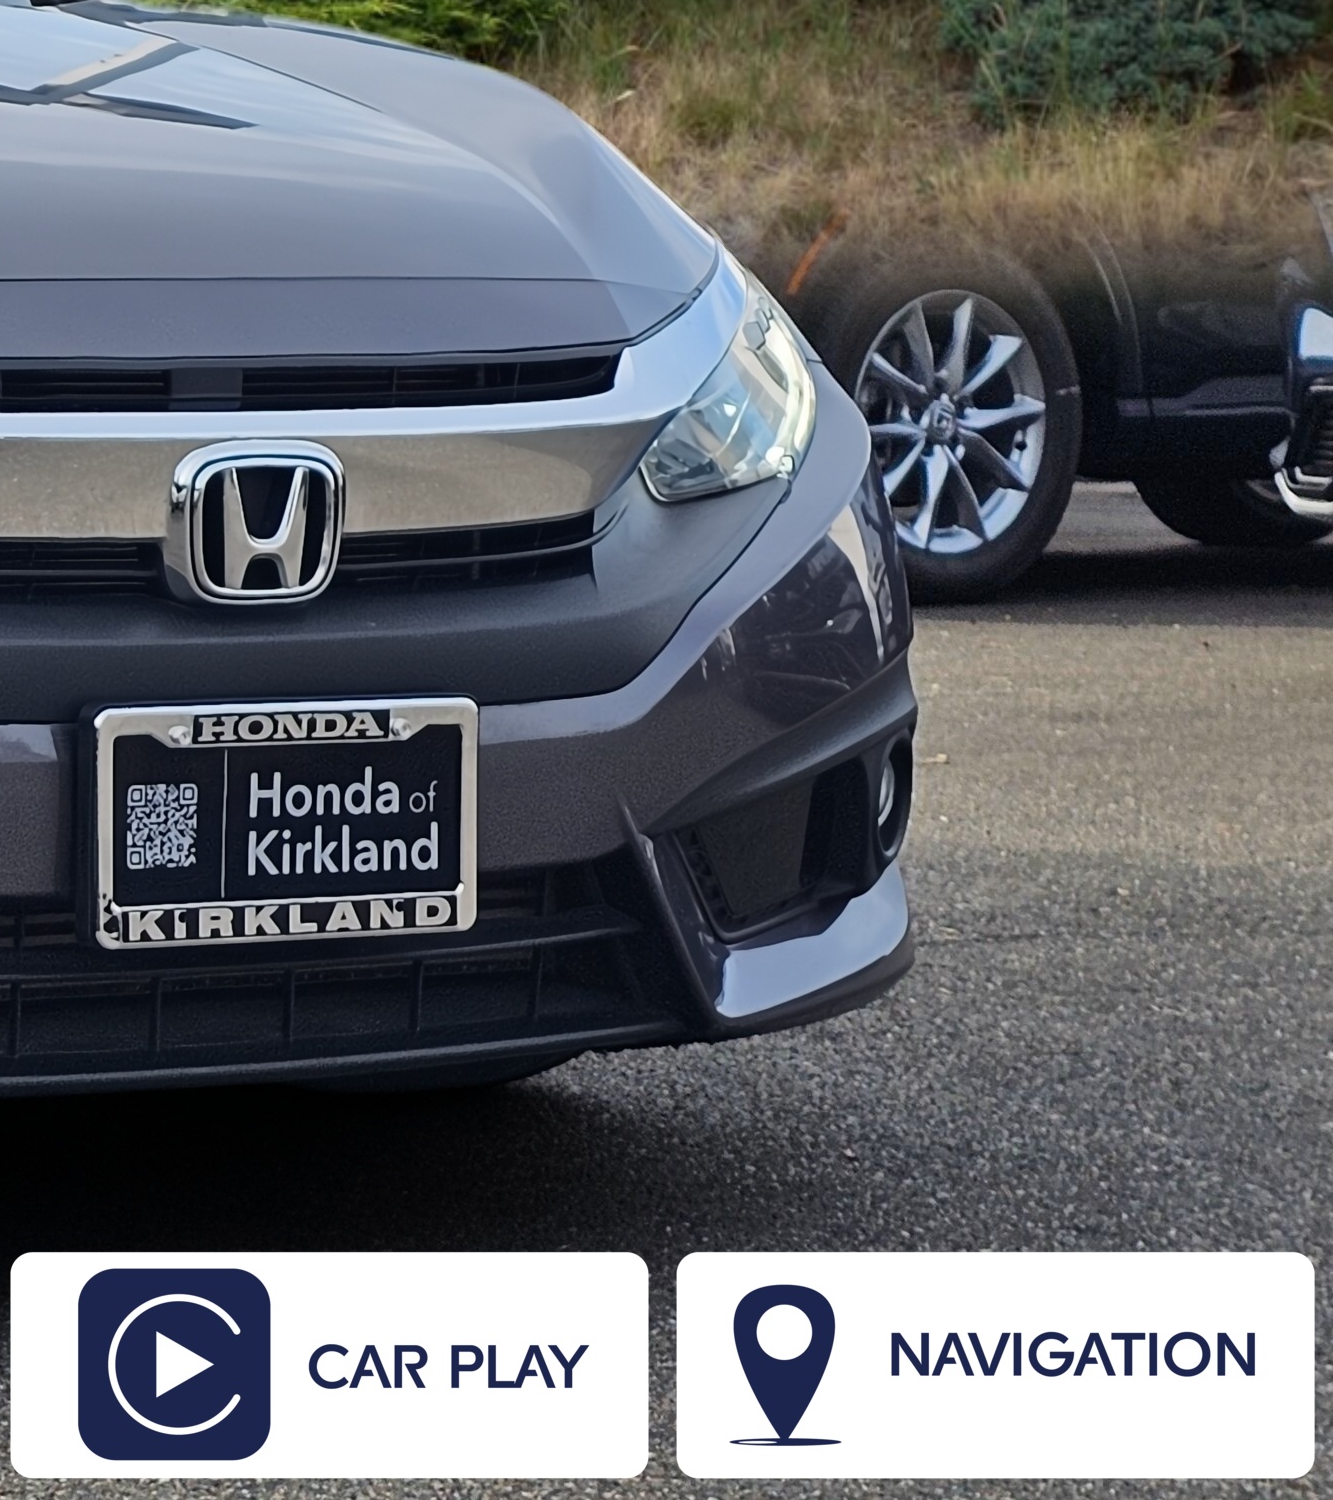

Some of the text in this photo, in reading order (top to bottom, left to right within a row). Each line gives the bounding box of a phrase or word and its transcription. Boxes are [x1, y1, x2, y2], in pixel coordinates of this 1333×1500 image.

[196, 711, 384, 743] HONDA
[248, 765, 438, 819] Honda of
[246, 821, 439, 877] Kirkland
[127, 896, 453, 942] KIRKLAND
